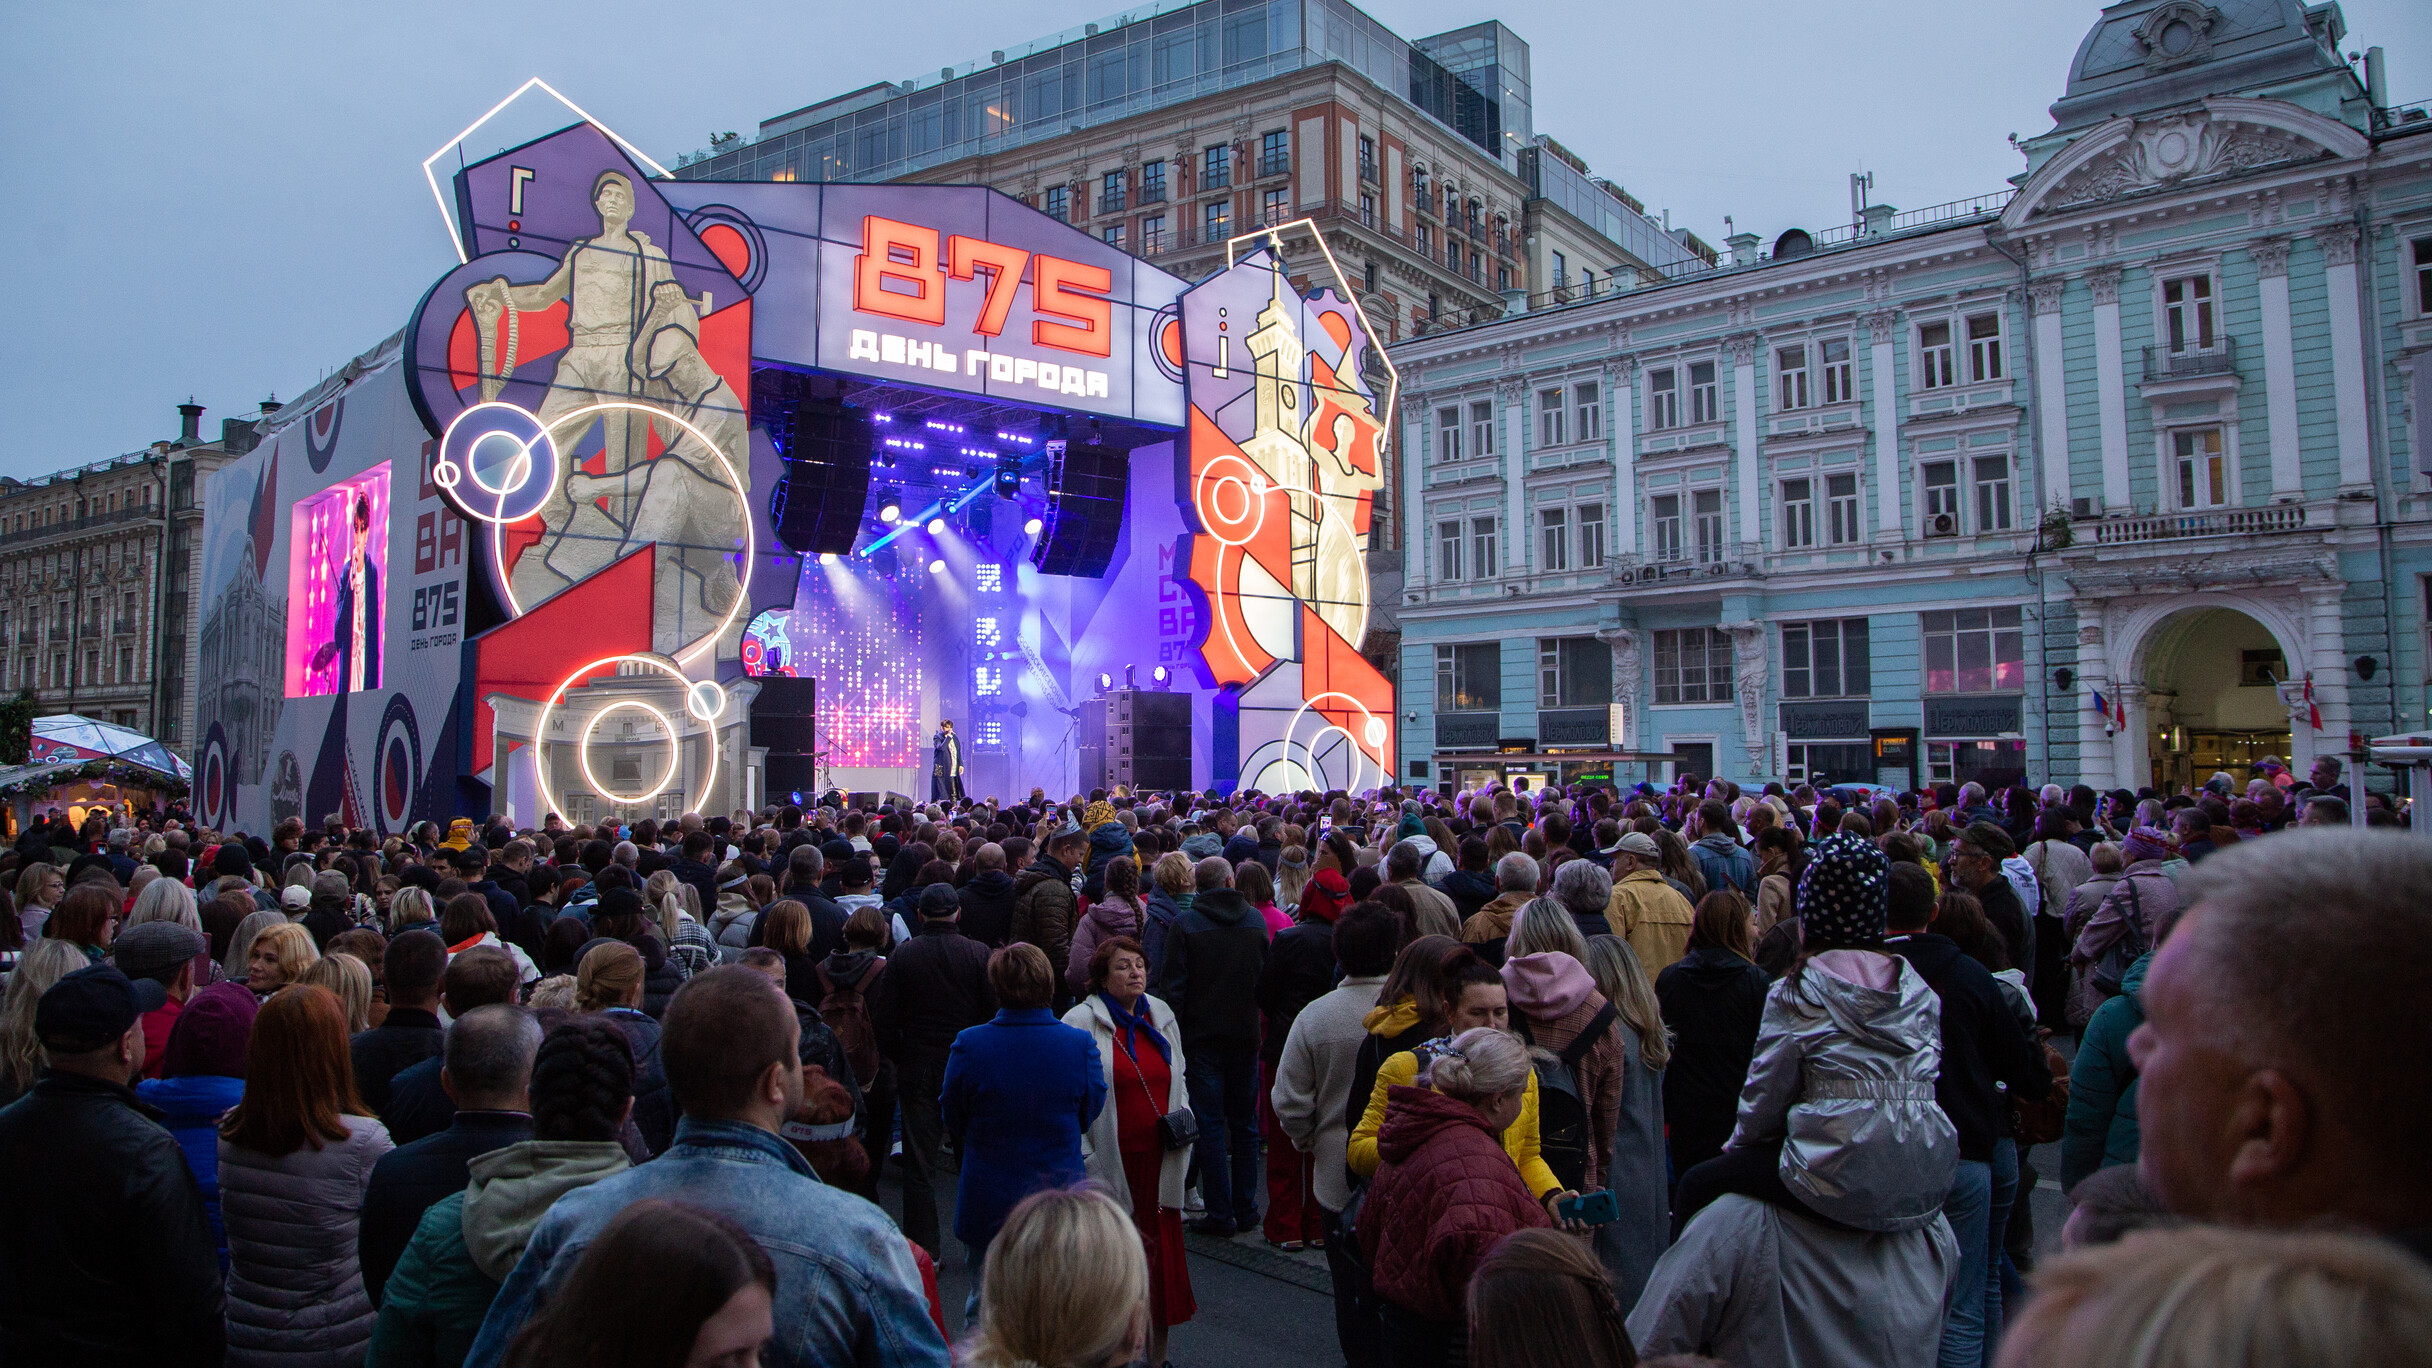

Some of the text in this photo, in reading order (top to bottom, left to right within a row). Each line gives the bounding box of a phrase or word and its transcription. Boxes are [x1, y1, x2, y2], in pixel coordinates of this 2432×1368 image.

[853, 214, 1112, 359] 875
[849, 329, 1109, 399] ДЕНЬ ГОРОДА
[412, 580, 460, 631] 875
[411, 633, 457, 651] ДЕНЬ ГОРОДА
